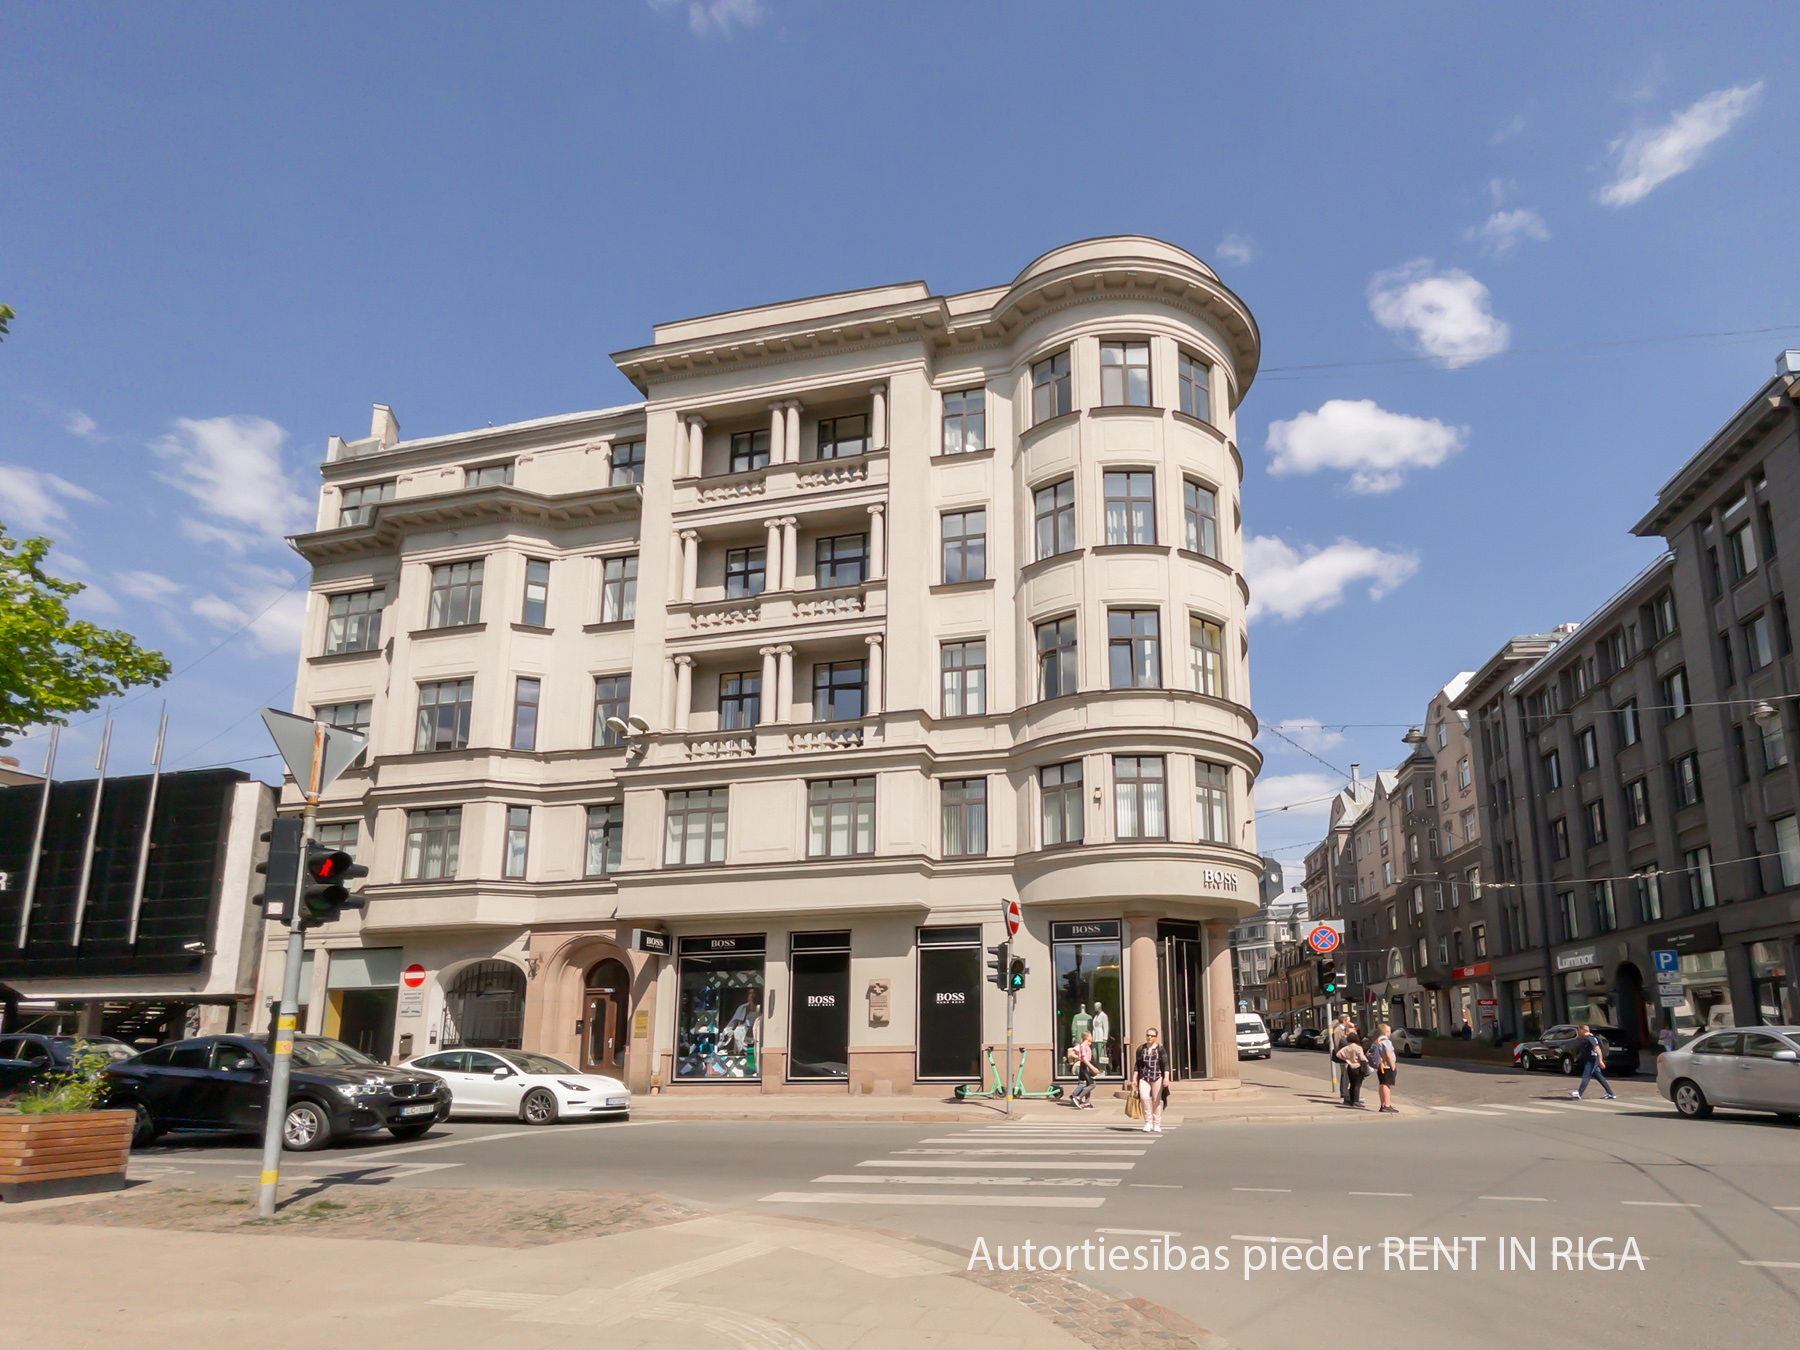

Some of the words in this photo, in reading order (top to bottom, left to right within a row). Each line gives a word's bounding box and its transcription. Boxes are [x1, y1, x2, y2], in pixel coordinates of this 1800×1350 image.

[1204, 869, 1238, 885] BOSS
[1072, 924, 1101, 934] BOSS
[646, 936, 664, 946] BOSS
[711, 939, 736, 948] BOSS
[1557, 951, 1594, 969] Luminor
[1659, 952, 1673, 969] P
[808, 995, 835, 1004] BOSS
[936, 992, 965, 1001] BOSS
